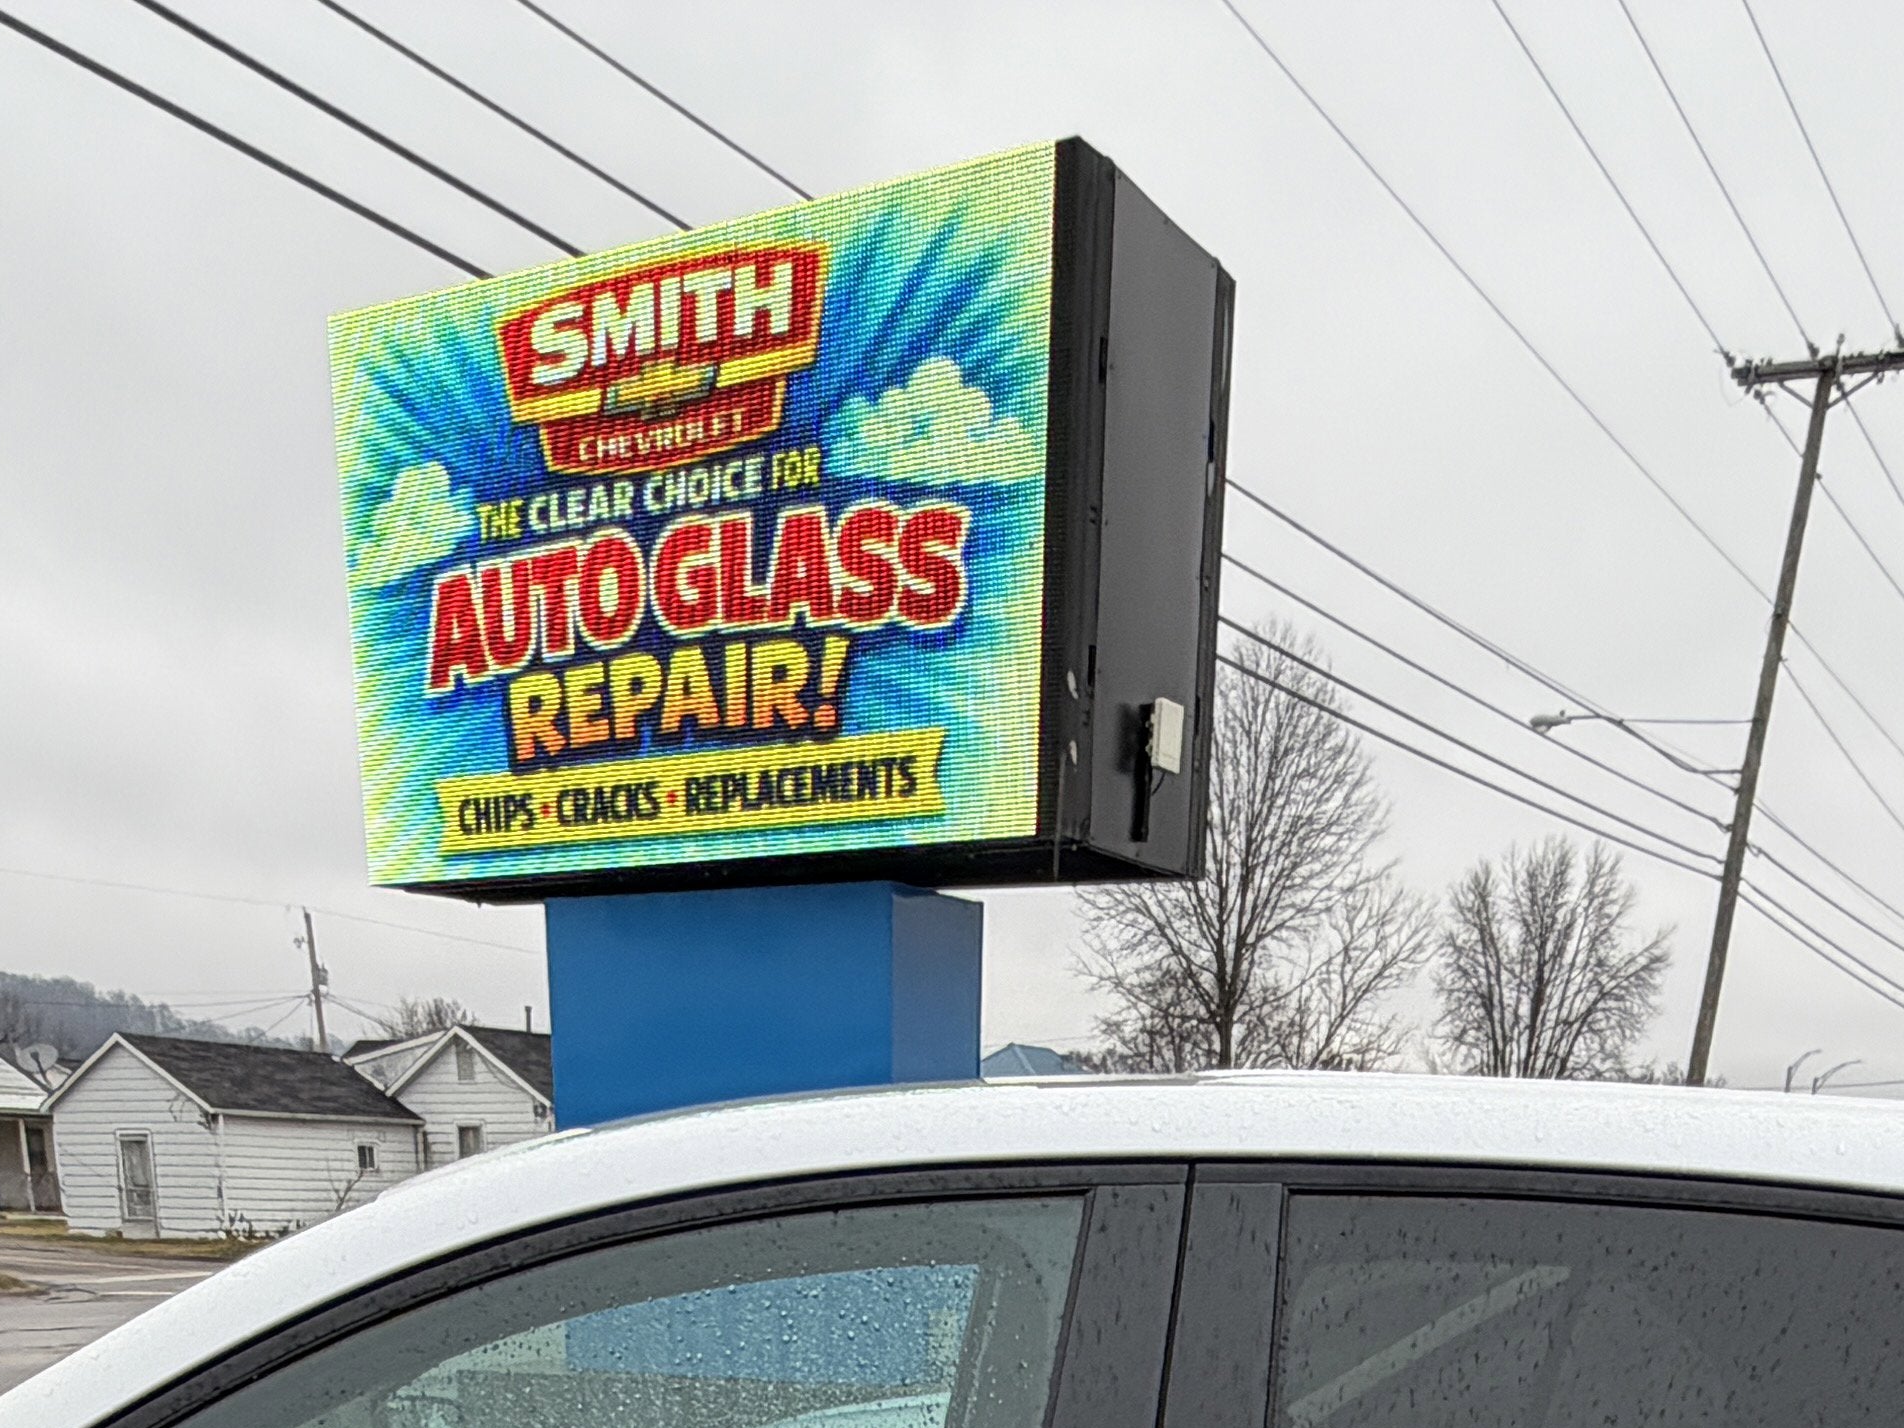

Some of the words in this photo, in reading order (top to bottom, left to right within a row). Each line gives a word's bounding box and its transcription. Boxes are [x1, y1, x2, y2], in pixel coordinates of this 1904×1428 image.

[531, 262, 793, 385] SMITH
[579, 409, 746, 461] CHEVROLET
[476, 499, 524, 542] THE
[529, 481, 634, 532] CLEAR
[645, 456, 765, 512] CHOICE
[772, 447, 821, 490] FOR
[425, 528, 645, 694] AUTO
[651, 500, 972, 636] GLASS
[508, 636, 850, 762] REPAIR!
[458, 793, 535, 836] CHIPS
[556, 781, 661, 827] CRACKS
[685, 755, 919, 816] REPLACEMENTS
